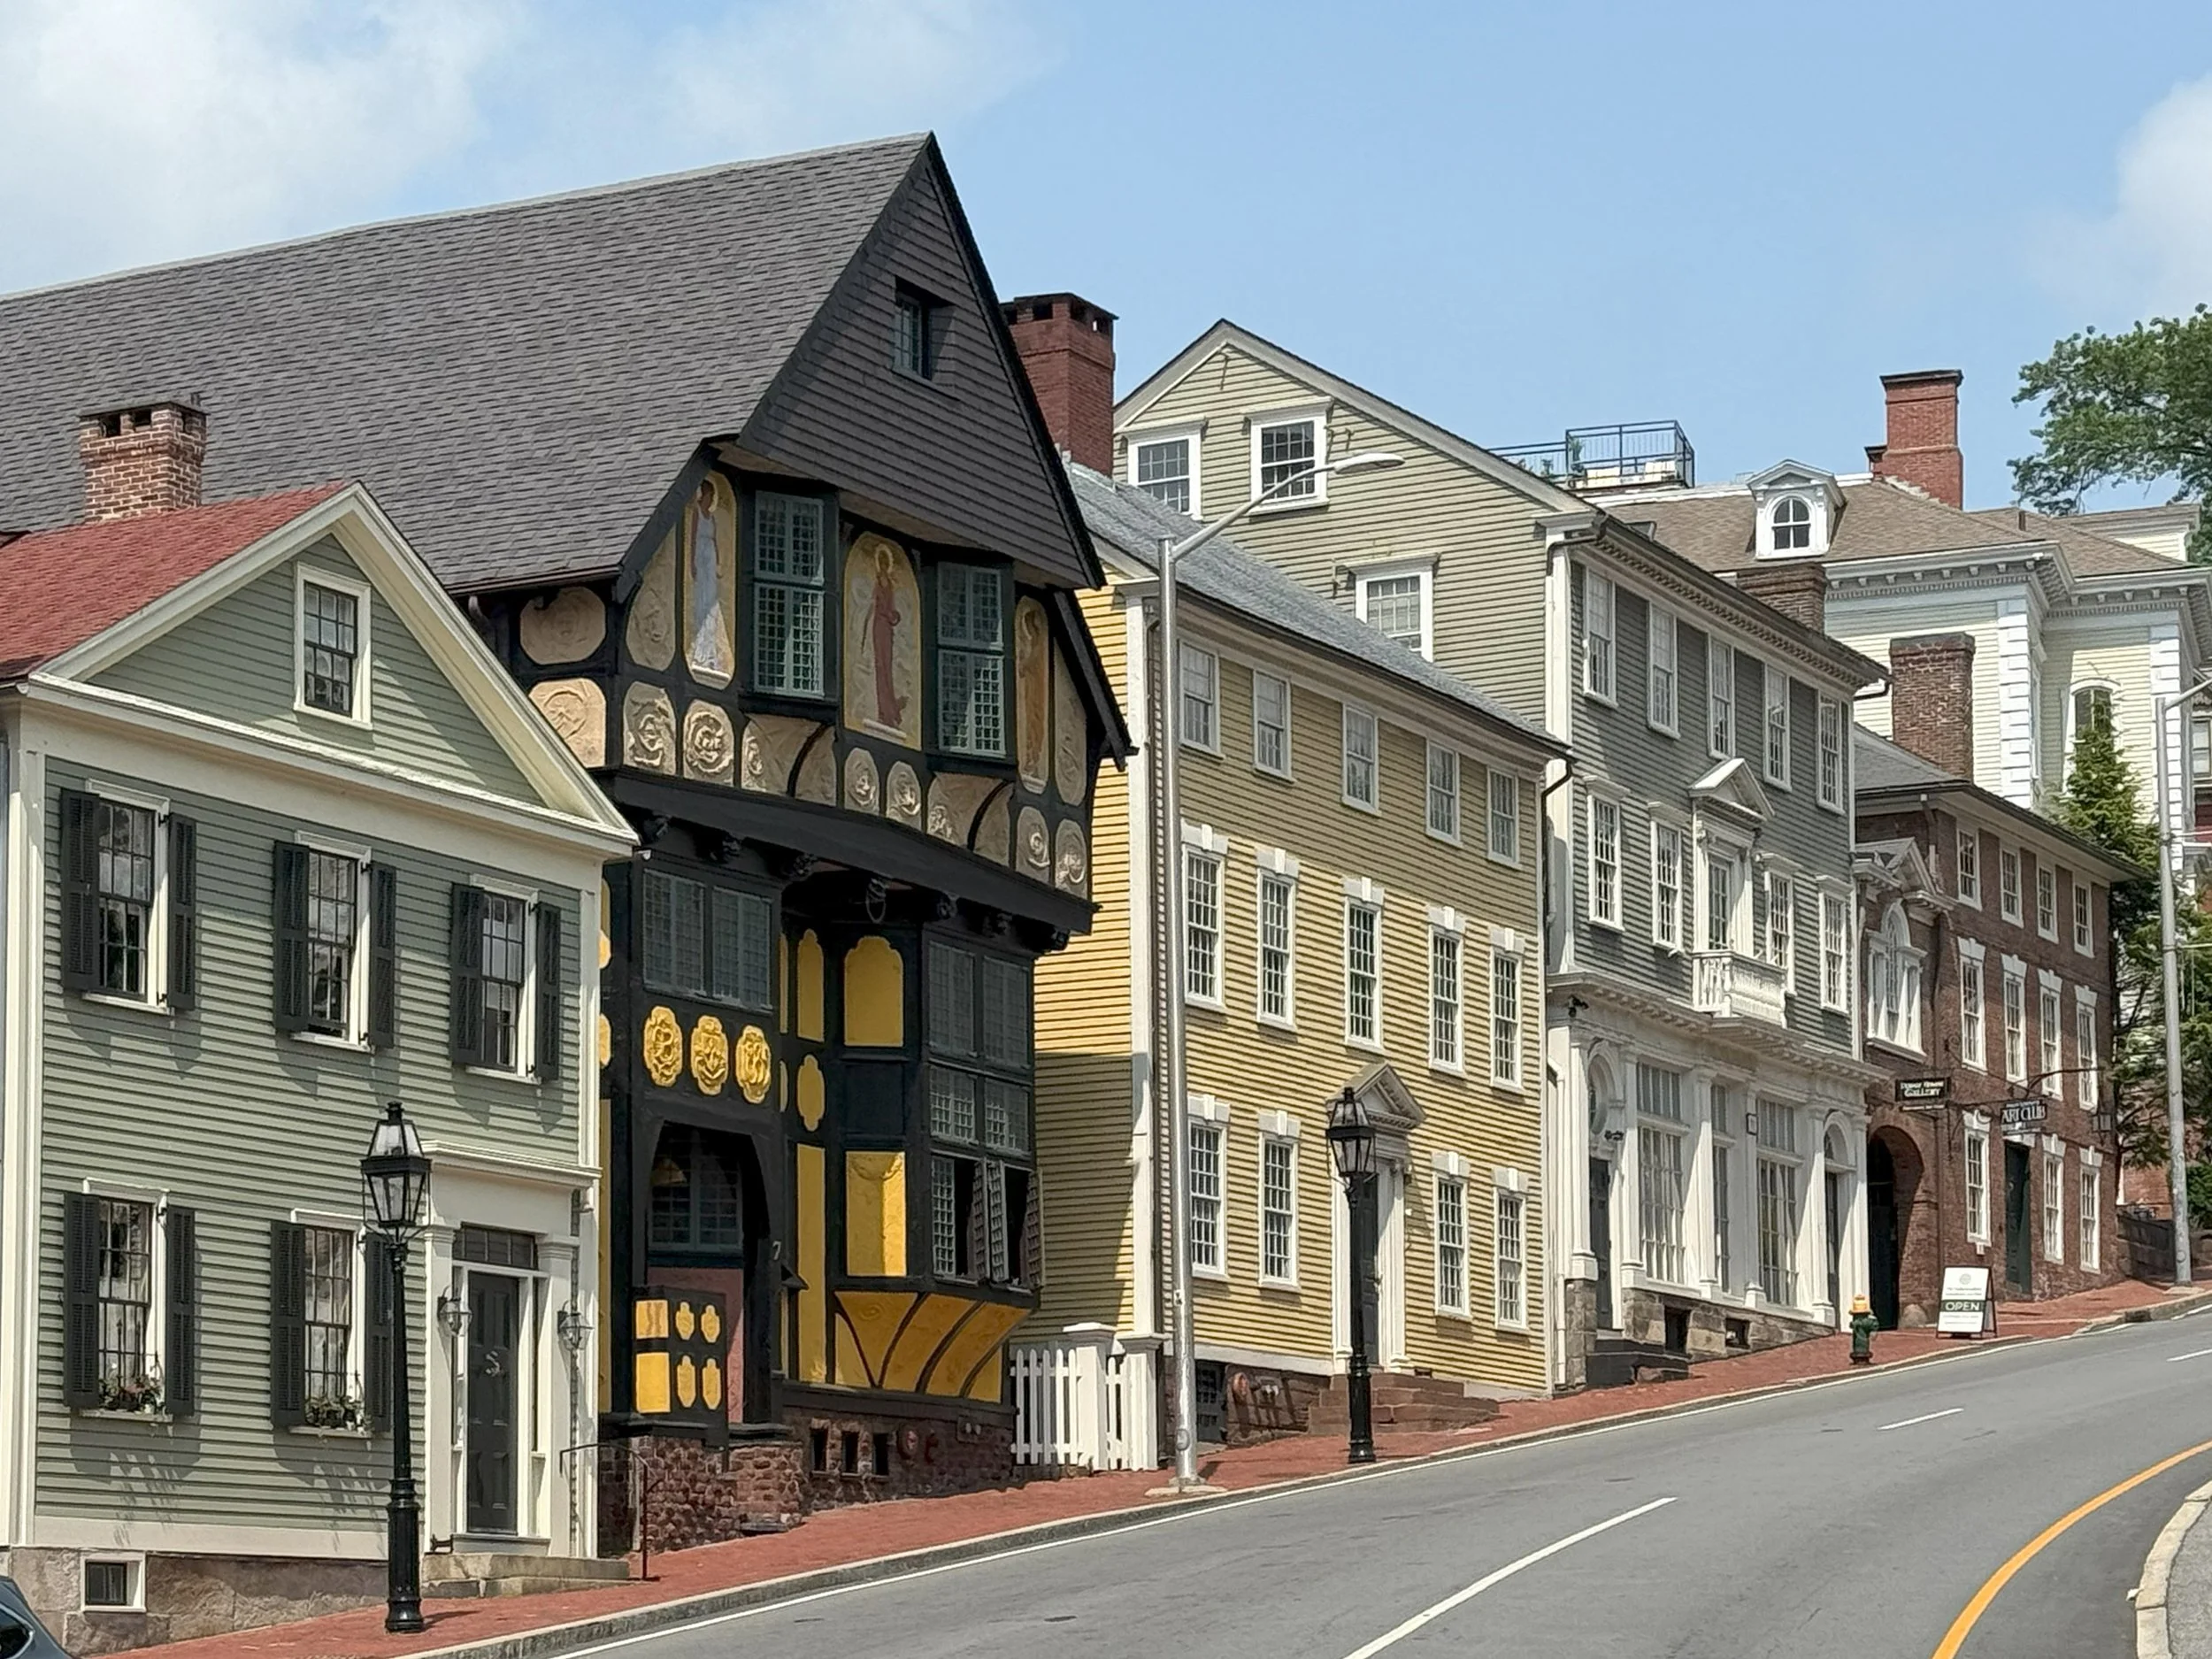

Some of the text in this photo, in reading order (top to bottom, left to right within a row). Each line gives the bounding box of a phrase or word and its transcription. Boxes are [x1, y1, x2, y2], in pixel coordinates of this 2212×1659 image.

[2001, 1105, 2046, 1123] ART CLUB
[772, 1240, 781, 1261] 7
[1945, 1302, 1980, 1311] OPEN
